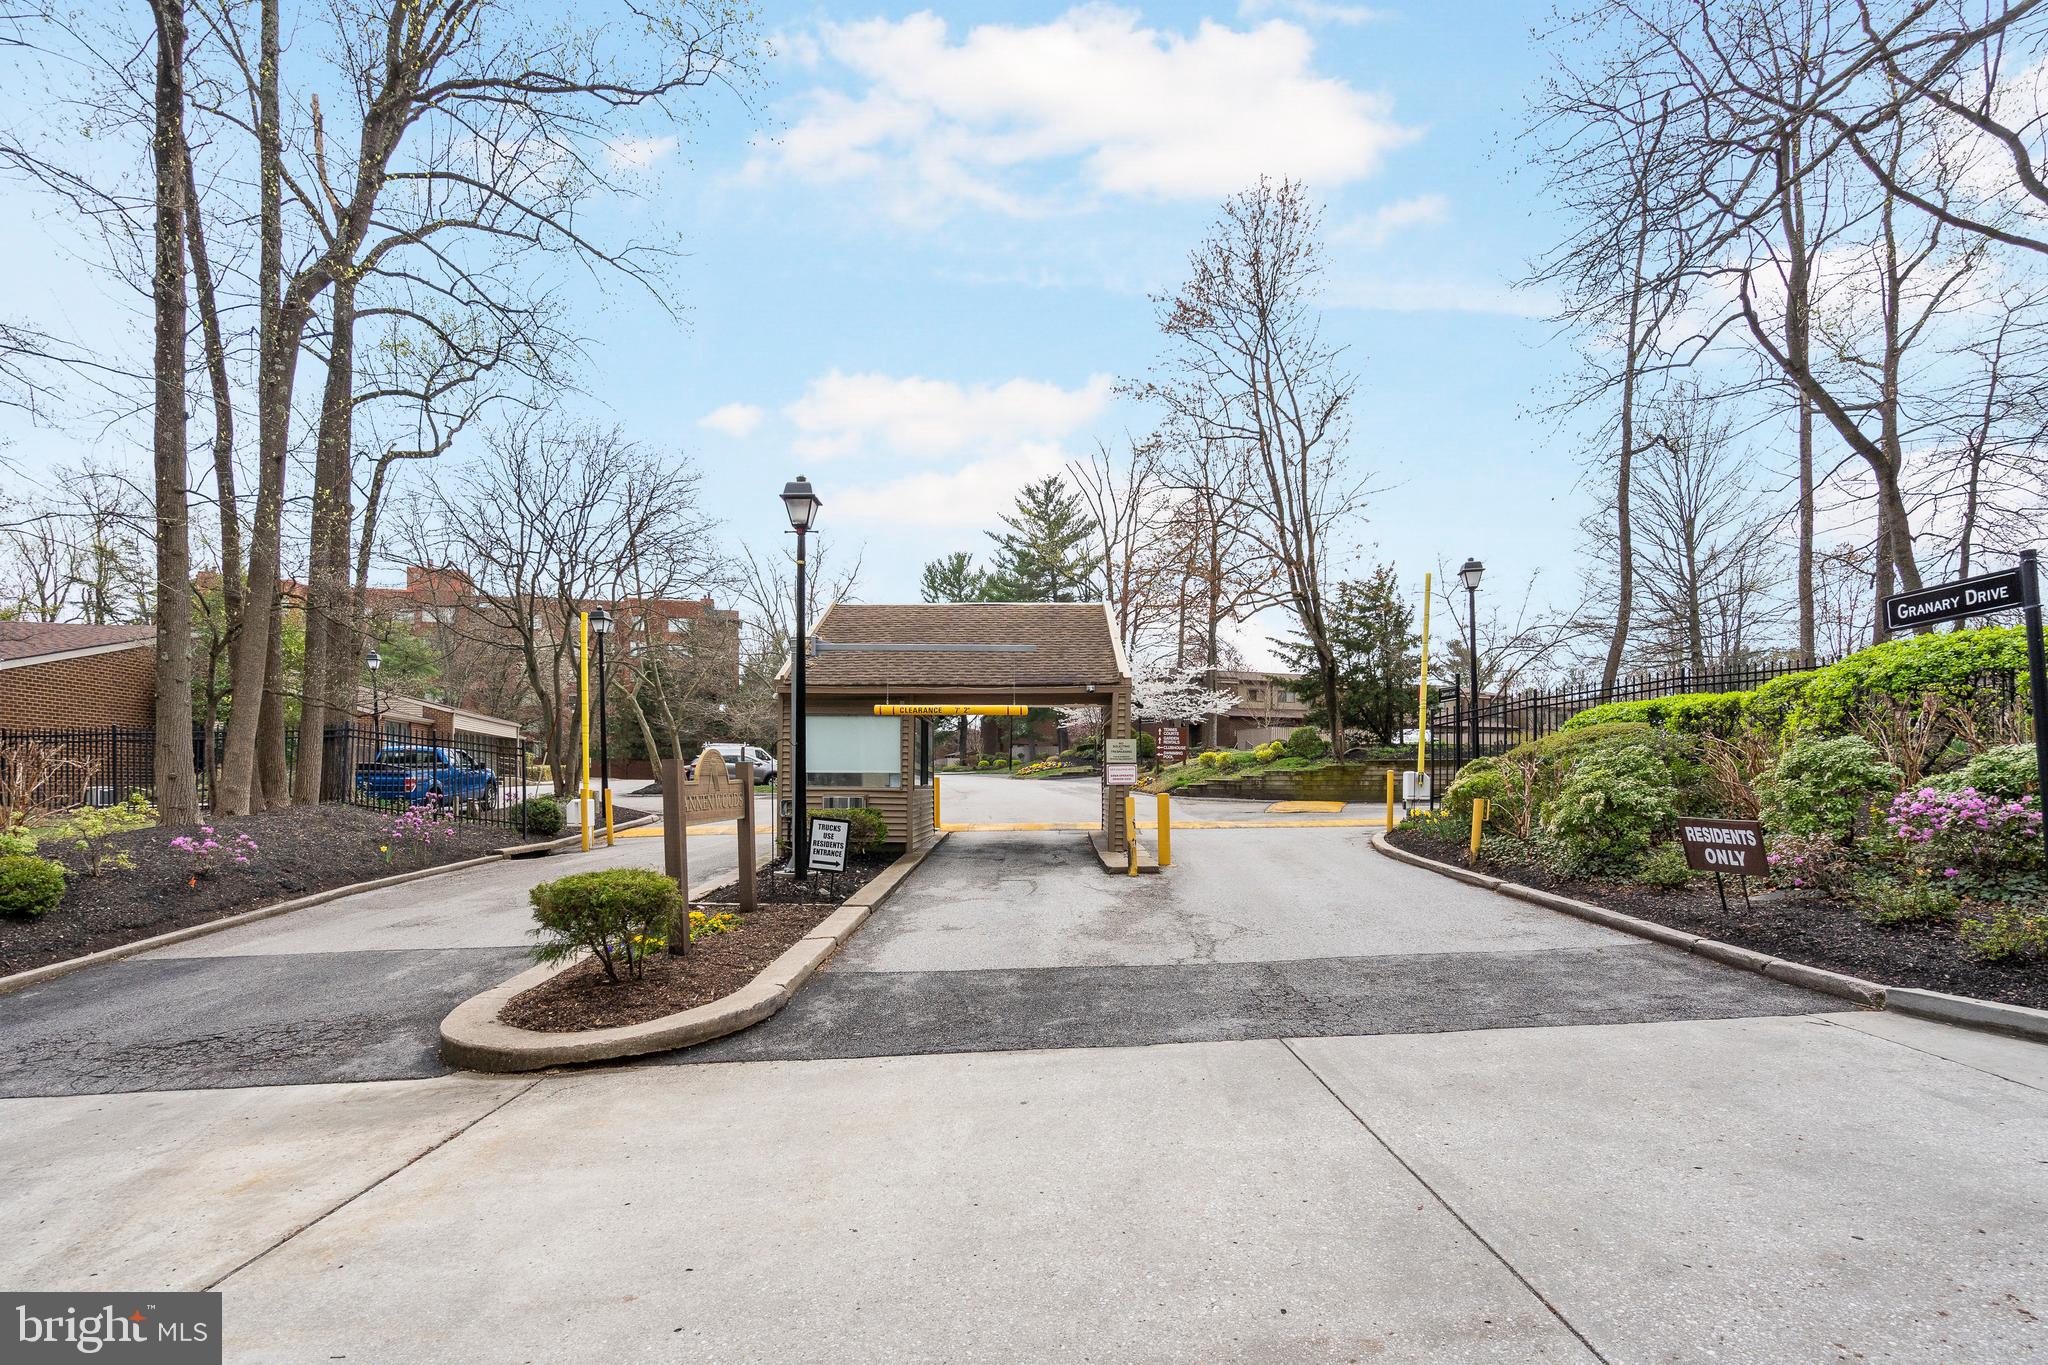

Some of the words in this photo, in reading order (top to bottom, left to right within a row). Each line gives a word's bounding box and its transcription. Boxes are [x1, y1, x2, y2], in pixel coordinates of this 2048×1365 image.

[1897, 596, 1960, 619] GRANARY
[1965, 586, 2009, 606] DRIVE
[685, 792, 744, 812] ANNENWOODS
[818, 824, 842, 832] TRUCKS
[1685, 826, 1756, 846] RESIDENTS
[812, 840, 844, 849] RESIDENTS
[812, 848, 842, 857] ENTRANCE
[1705, 848, 1746, 866] ONLY
